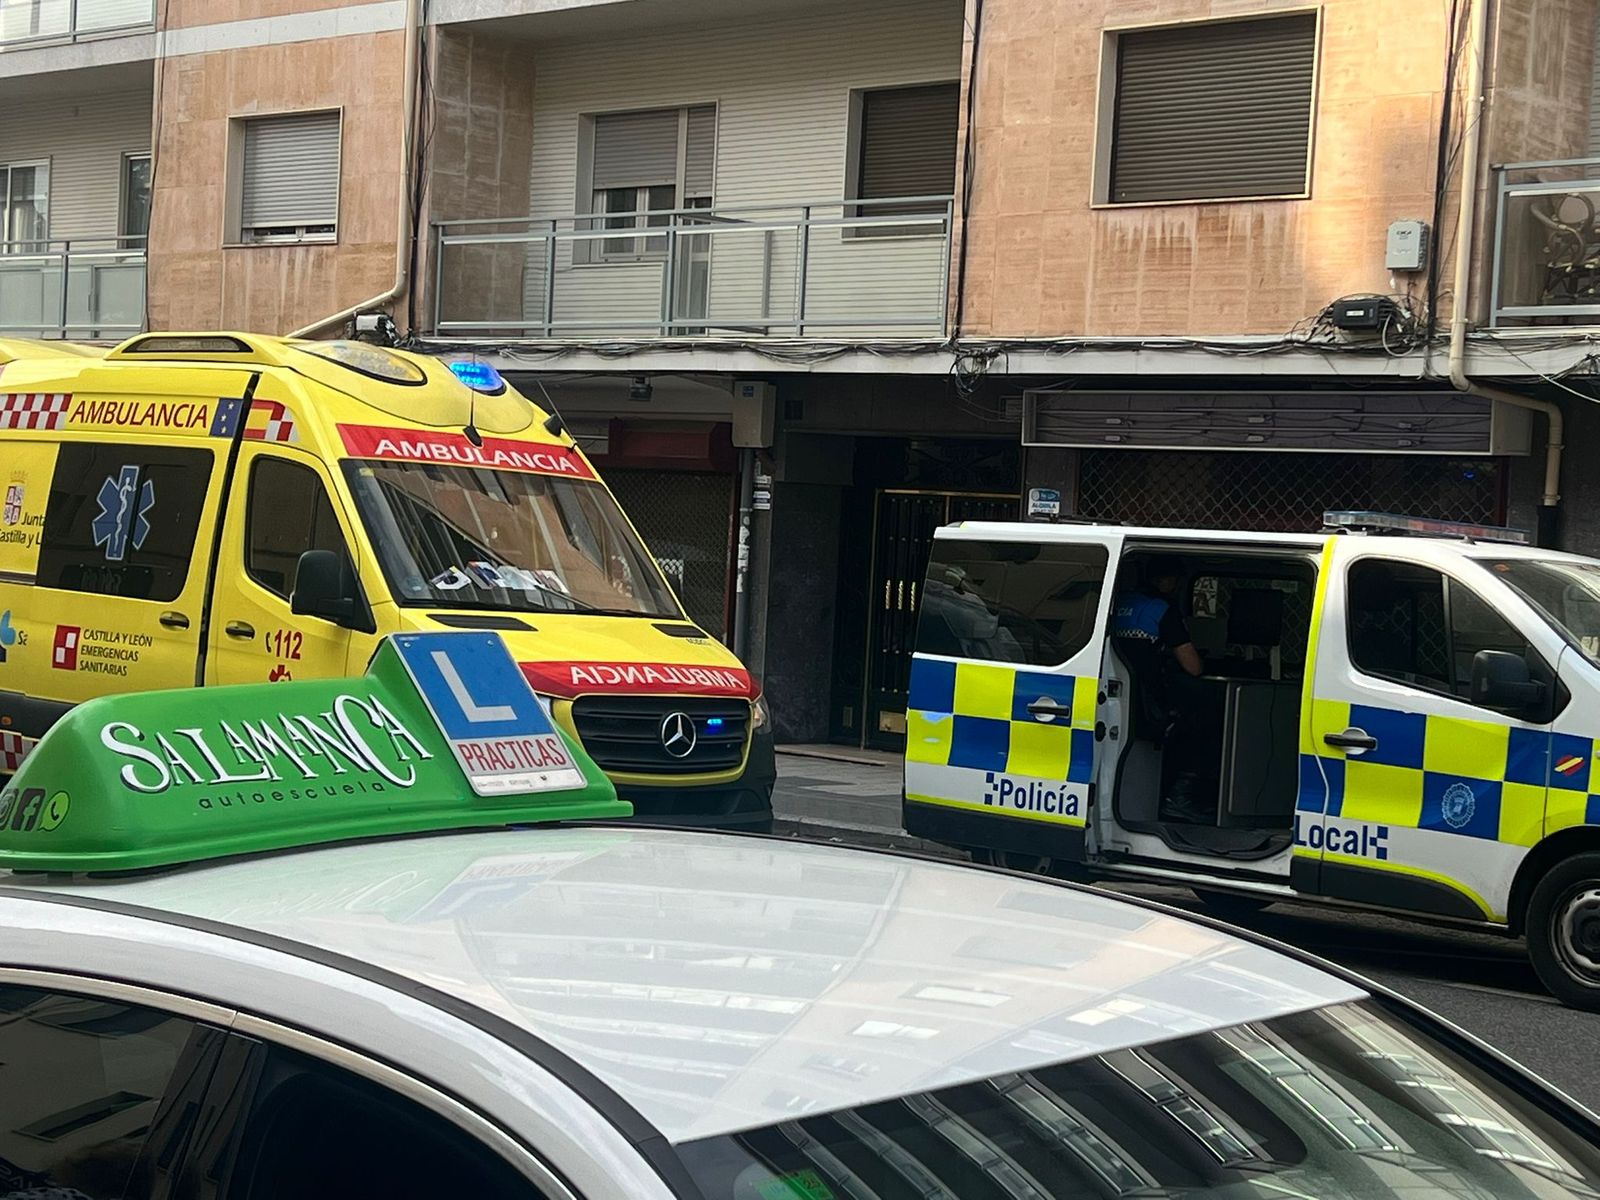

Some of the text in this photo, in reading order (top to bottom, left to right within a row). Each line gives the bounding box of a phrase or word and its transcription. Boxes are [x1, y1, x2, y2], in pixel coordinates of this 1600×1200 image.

[69, 400, 208, 428] AMBULANCIA
[374, 439, 580, 474] AMBULANCIA
[0, 529, 26, 544] astilla
[26, 534, 34, 549] y
[81, 645, 139, 662] EMERGENCIAS
[83, 629, 153, 647] CASTILLA Y LEÓN
[274, 629, 303, 660] 112
[79, 660, 127, 677] SANITARIAS
[430, 650, 517, 722] L
[100, 694, 434, 793] SALAMANCA
[457, 738, 566, 772] PRACTICAS
[198, 781, 386, 810] autoescuela
[999, 778, 1078, 816] Policía
[1294, 815, 1368, 857] Local
